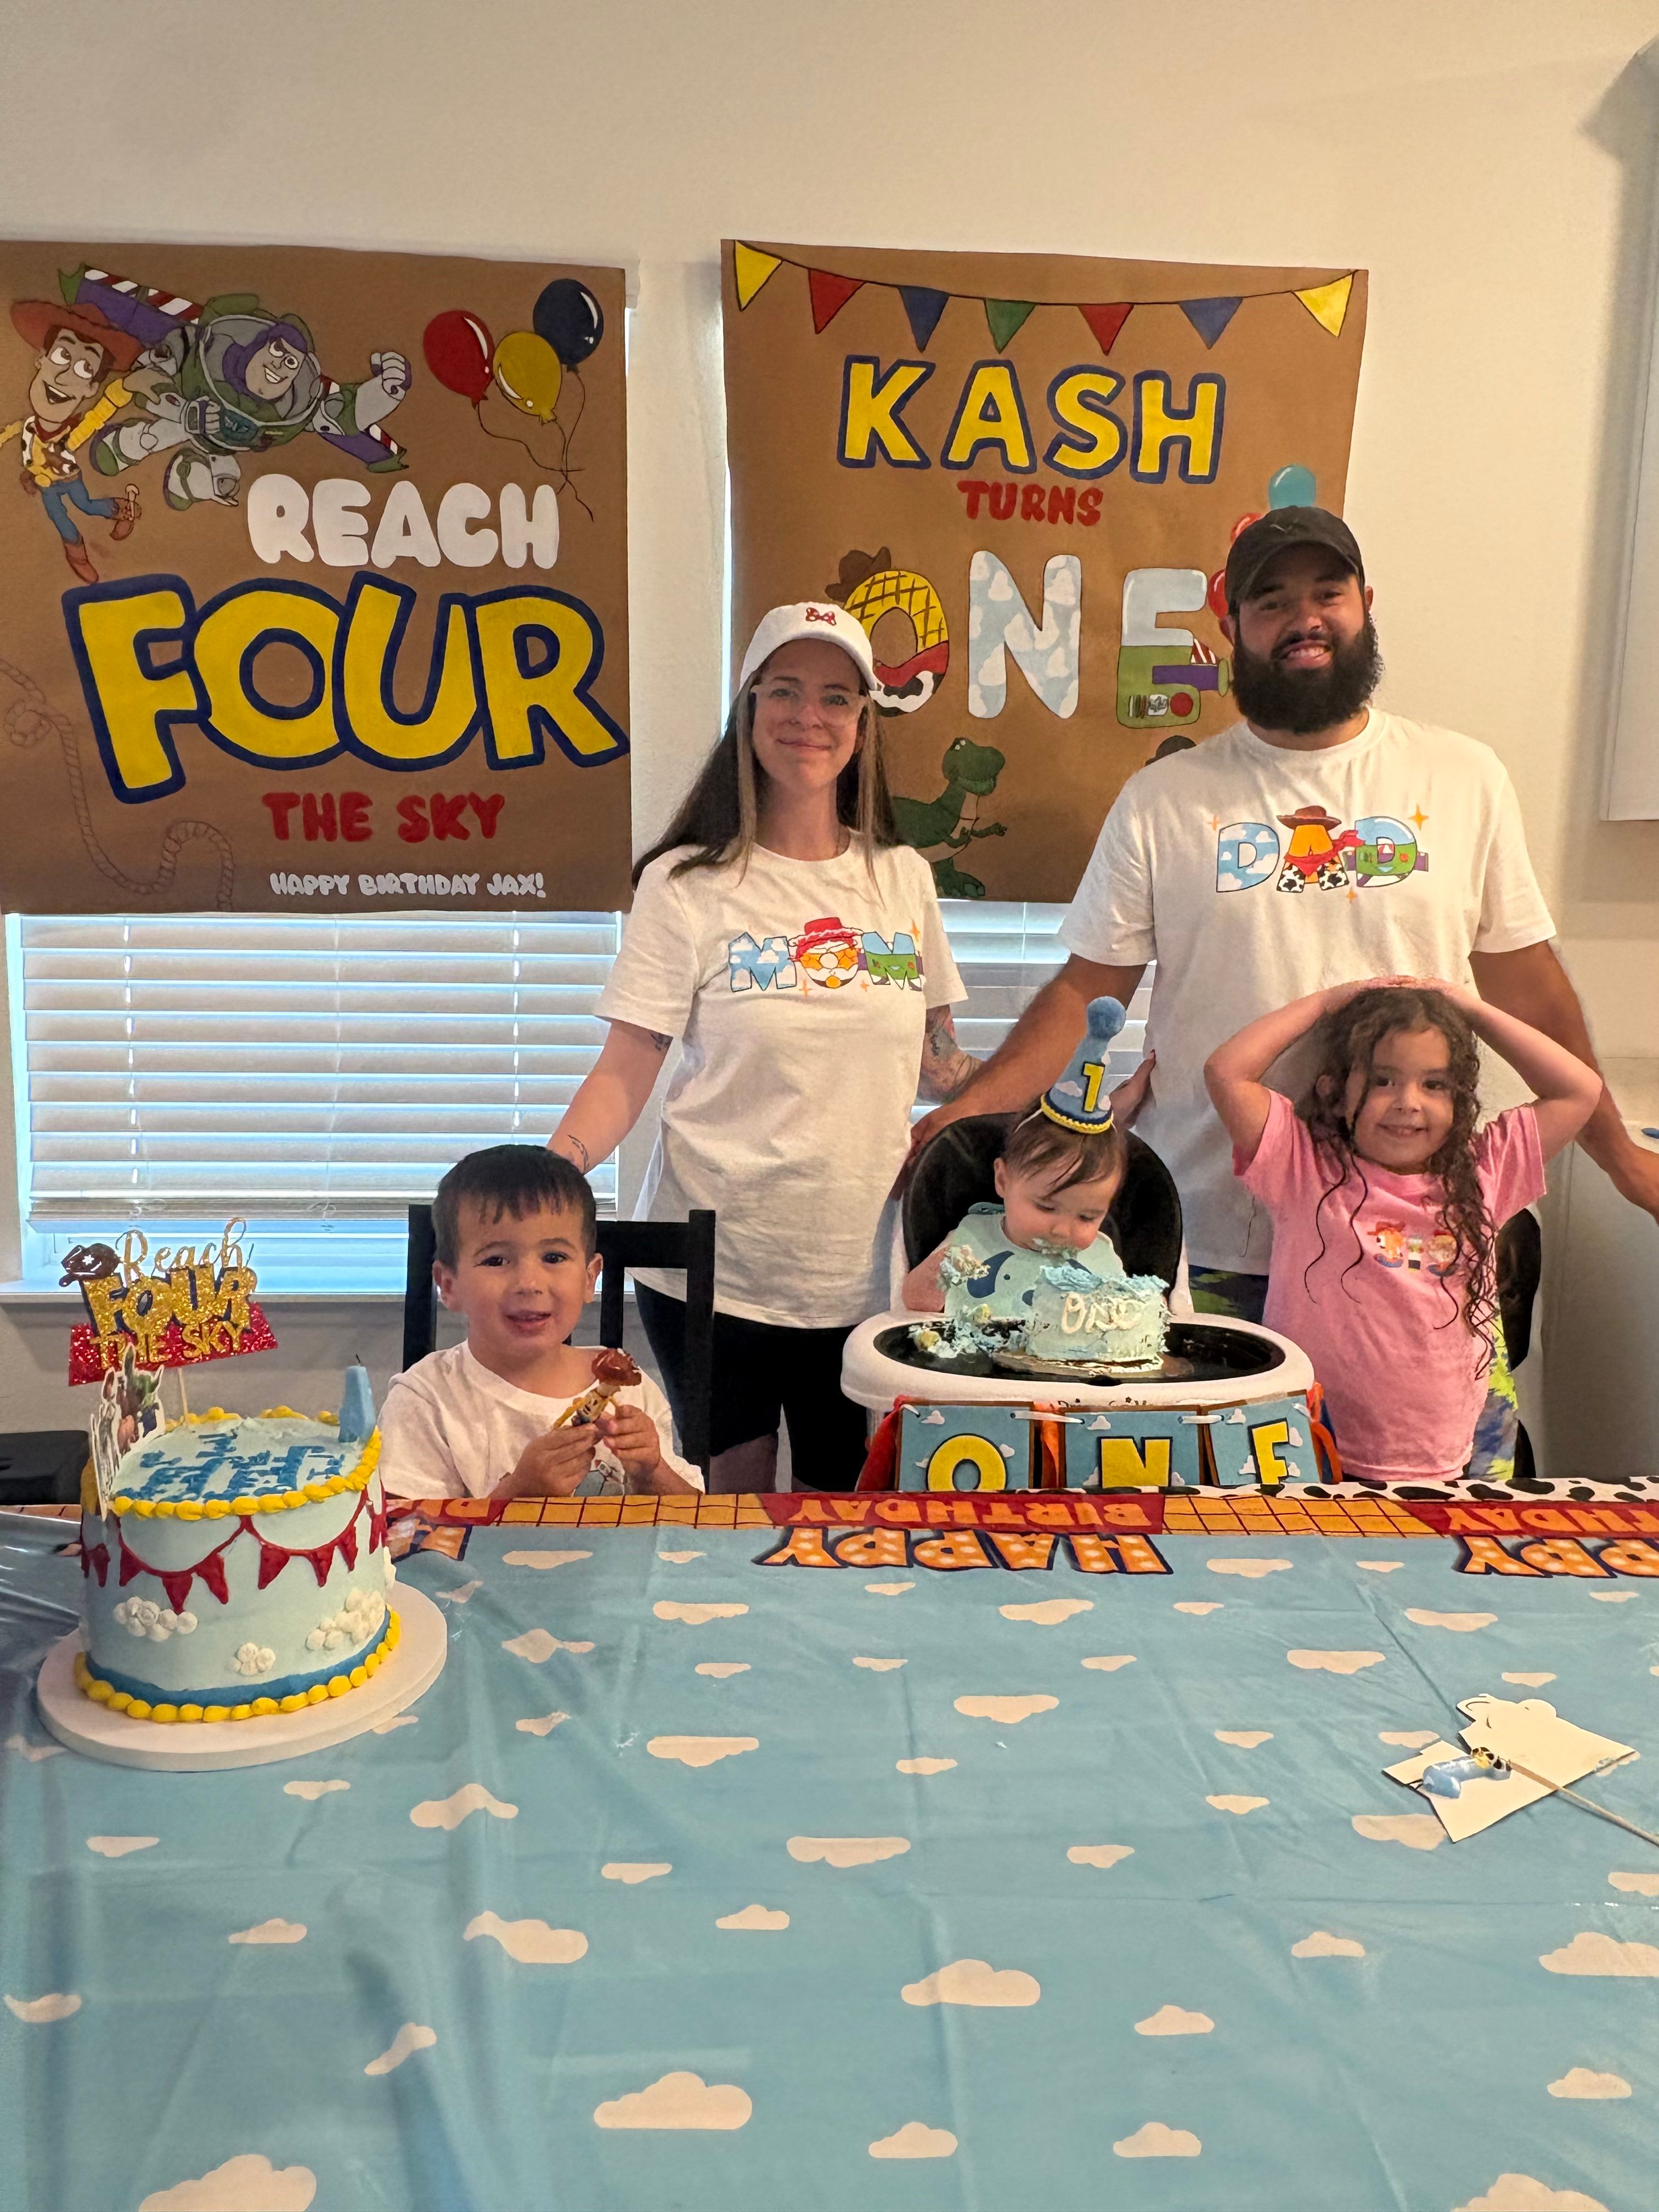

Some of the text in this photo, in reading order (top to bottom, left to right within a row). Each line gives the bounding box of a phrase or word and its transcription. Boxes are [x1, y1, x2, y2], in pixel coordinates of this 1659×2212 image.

[837, 355, 1225, 484] KASH
[246, 473, 560, 569] REACH
[957, 479, 1104, 527] TURNS
[844, 550, 1208, 729] ONE
[62, 571, 631, 804] FOUR
[262, 791, 505, 844] THE SKY
[1216, 815, 1418, 893] DAD
[269, 872, 547, 899] HAPPY BIRTHDAY JAX!
[728, 927, 923, 993] MOM
[1081, 1062, 1105, 1113] 1
[115, 1217, 255, 1288] Reach
[80, 1265, 258, 1338] FOUR
[182, 1319, 245, 1359] SKY
[787, 1498, 1152, 1526] BIRTHDAY
[751, 1525, 1174, 1575] HAPPY
[1451, 1534, 1659, 1578] PPY
